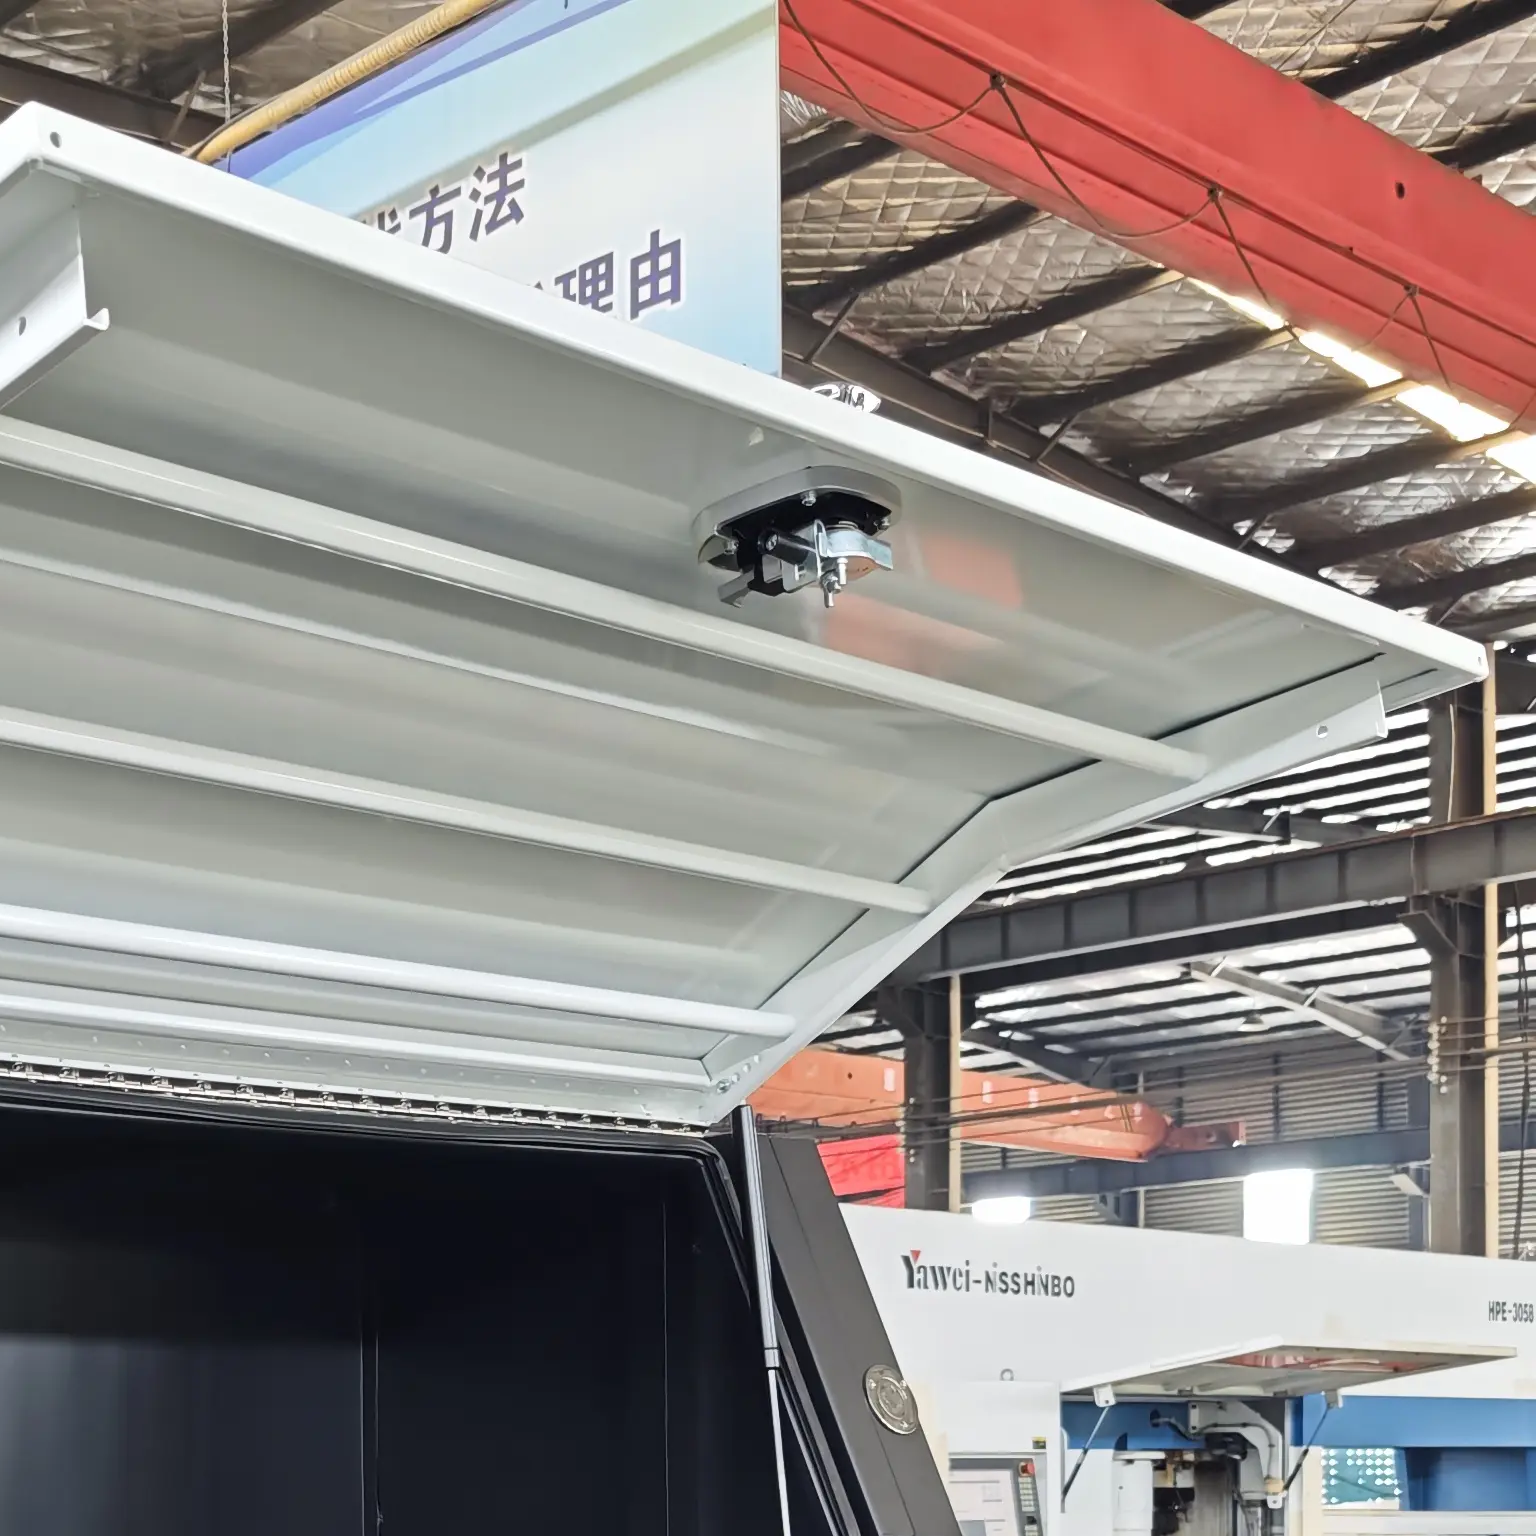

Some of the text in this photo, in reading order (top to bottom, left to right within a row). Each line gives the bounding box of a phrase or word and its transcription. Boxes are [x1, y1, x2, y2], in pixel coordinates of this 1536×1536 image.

[362, 152, 525, 254] 方法
[527, 228, 682, 321] 理由
[1488, 1299, 1534, 1324] HPE-3058
